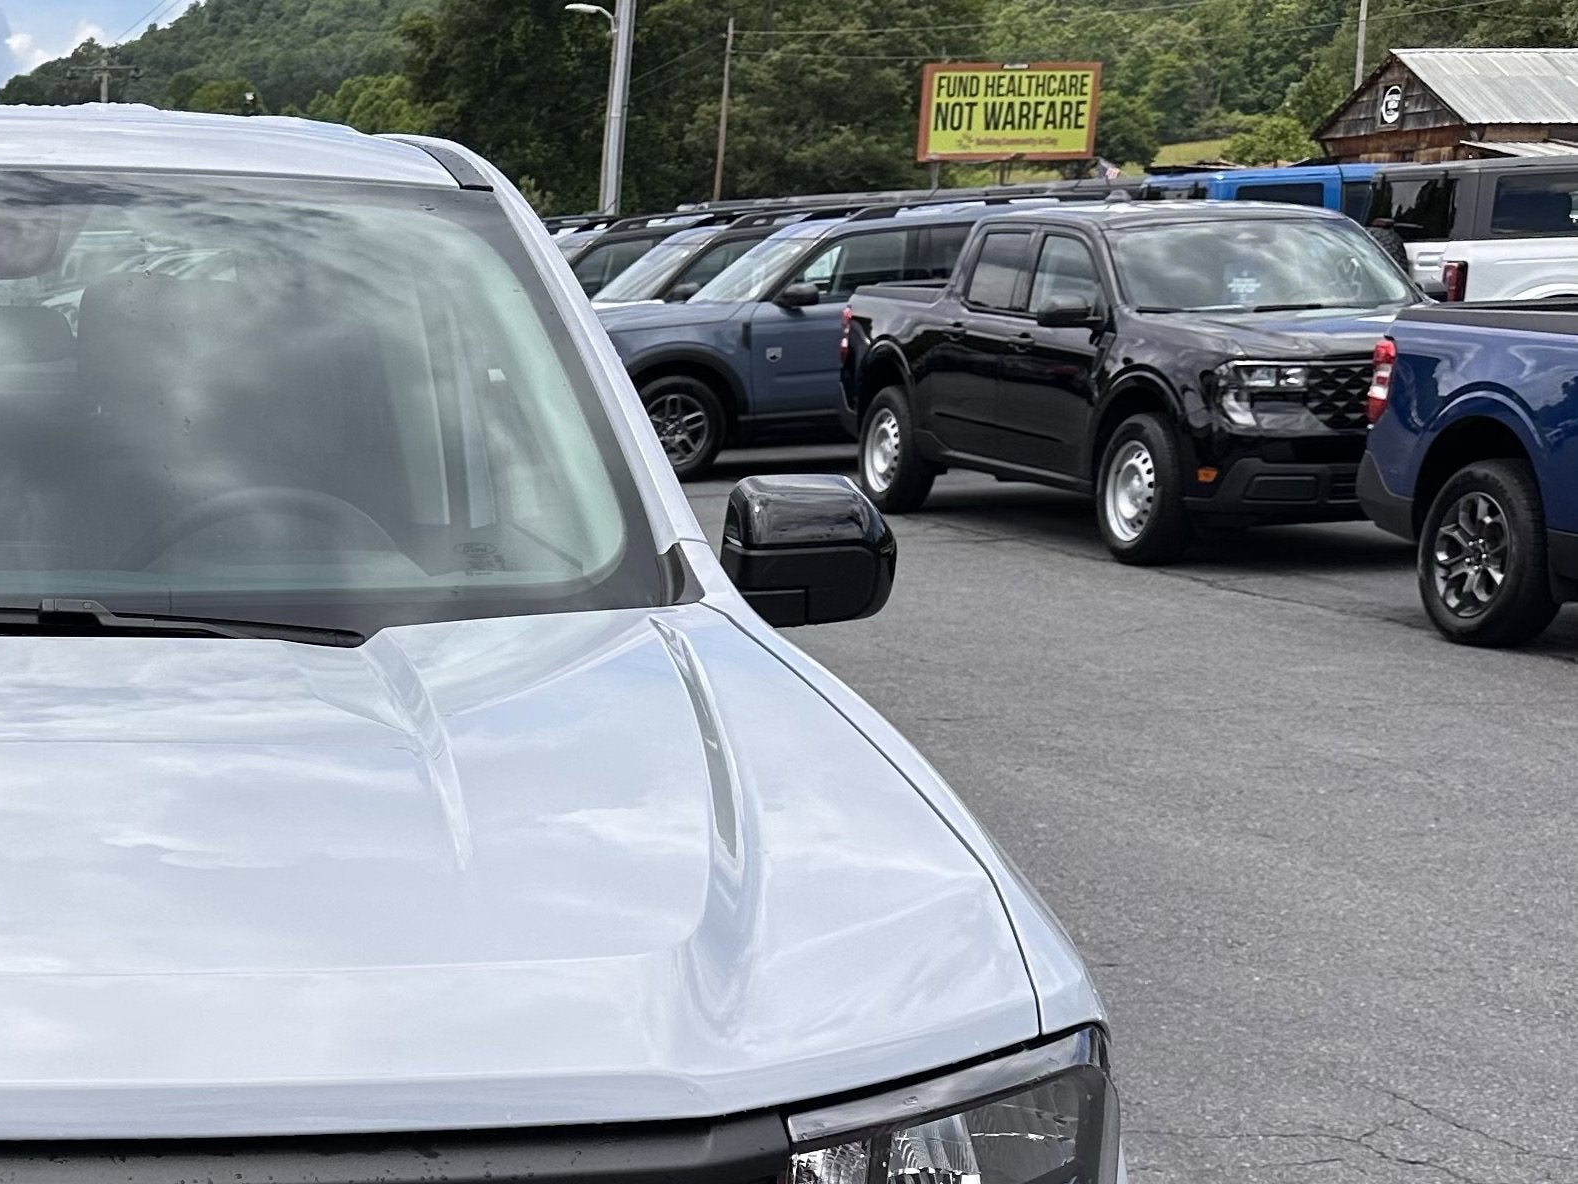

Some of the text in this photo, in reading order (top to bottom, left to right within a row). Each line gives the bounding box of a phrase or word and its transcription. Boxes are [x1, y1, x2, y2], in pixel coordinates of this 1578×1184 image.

[936, 74, 1090, 98] FUND HEALTHCARE
[933, 100, 1087, 131] NOT WARFARE
